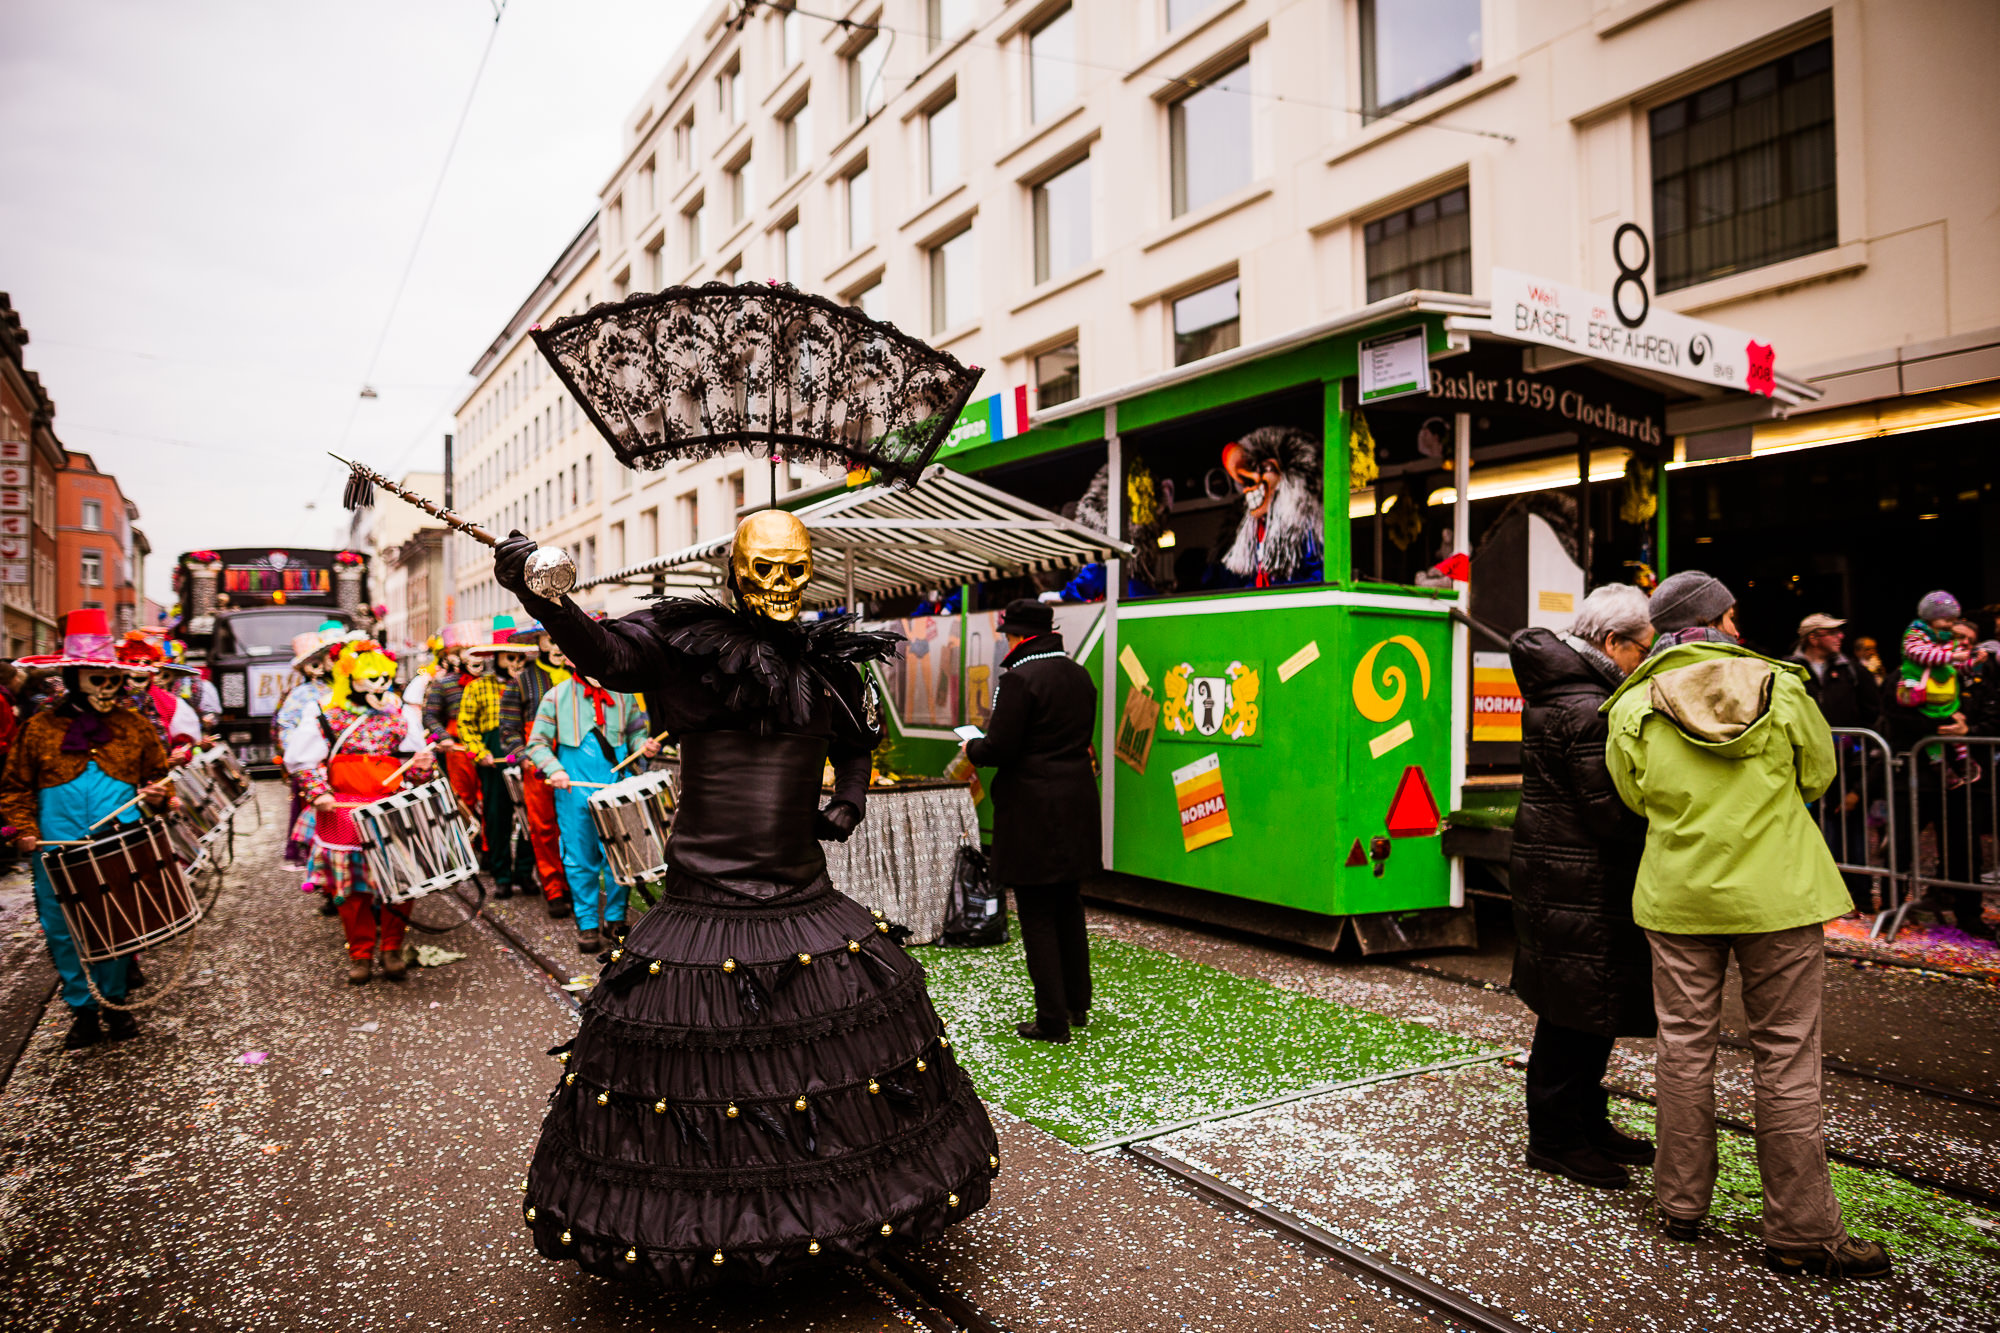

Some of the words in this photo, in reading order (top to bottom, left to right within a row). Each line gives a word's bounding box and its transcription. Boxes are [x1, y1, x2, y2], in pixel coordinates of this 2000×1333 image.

[1613, 222, 1650, 329] 8
[1515, 303, 1576, 344] BASEL
[1588, 321, 1680, 367] ERFAHREN
[1428, 368, 1498, 400] Basler
[1504, 377, 1556, 411] 1959
[1559, 390, 1662, 446] Clochards
[1474, 695, 1524, 713] NORMA
[1181, 796, 1225, 826] NORMA
